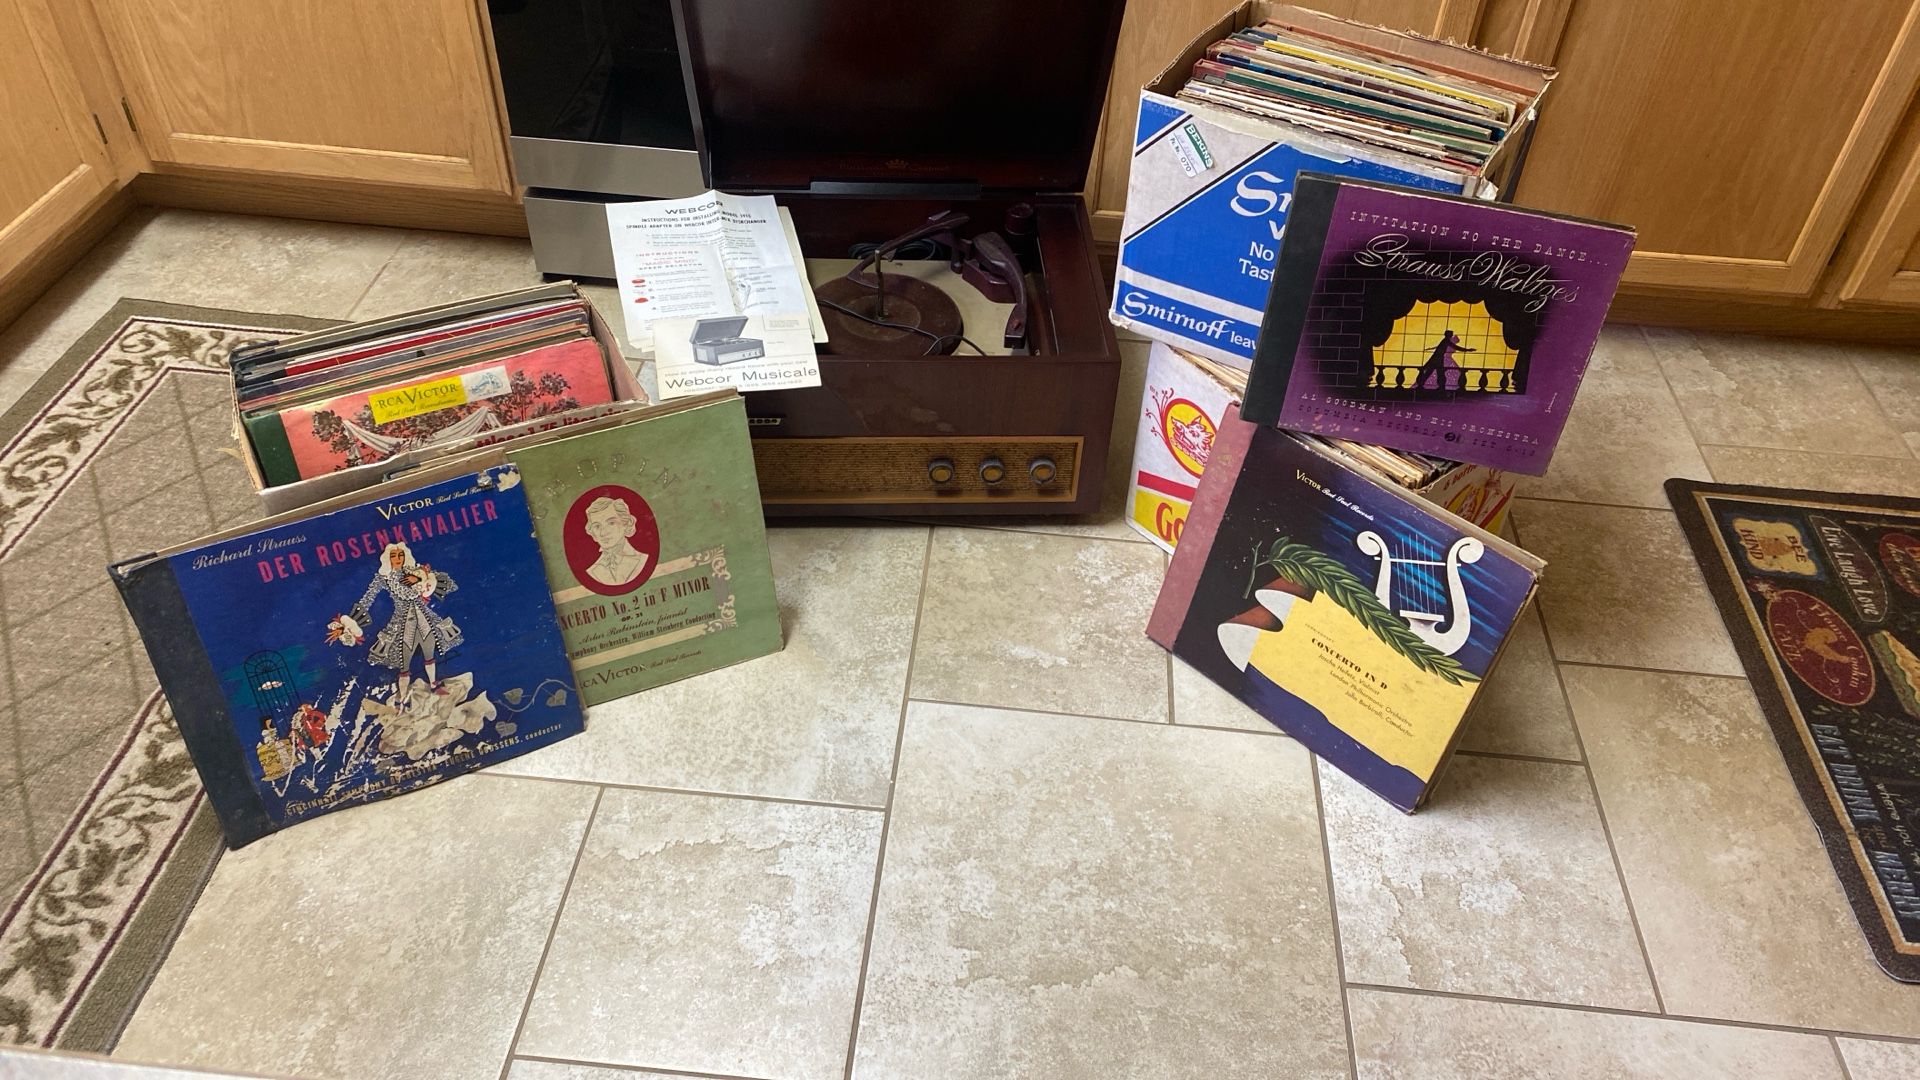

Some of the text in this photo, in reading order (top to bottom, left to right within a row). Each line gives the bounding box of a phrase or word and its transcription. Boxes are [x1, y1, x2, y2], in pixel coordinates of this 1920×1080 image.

[1181, 157, 1192, 172] 070
[1186, 124, 1213, 168] BEKINS
[665, 200, 723, 214] WEBCOR
[1350, 211, 1450, 236] INVITATION
[1461, 230, 1479, 242] TO
[1491, 235, 1522, 250] THE
[1249, 241, 1275, 261] No
[1239, 258, 1275, 282] Tast
[1354, 233, 1580, 313] Strauss Waltzes
[1122, 292, 1257, 350] Smirnoff leav
[377, 383, 458, 409] RCA VICTOR
[665, 375, 732, 389] Webcor
[742, 367, 817, 381] Musicale
[1298, 404, 1366, 424] COLUMBIA
[1472, 438, 1497, 449] SET
[1301, 393, 1539, 445] AL GOODMAN AND HIS ORCHESTRA
[376, 498, 434, 520] VICTOR
[435, 494, 452, 504] Red
[452, 489, 468, 500] Seal
[1296, 469, 1322, 491] VICTOR
[1350, 504, 1374, 521] Records
[192, 534, 307, 571] Richard Strauss
[257, 500, 498, 583] DER ROSENKAVALIER
[1740, 528, 1764, 560] KIND
[1785, 534, 1808, 563] BEE
[1820, 526, 1879, 615] Live Laugh Love
[560, 576, 710, 631] NCERTO No. 2 in F MINOR
[656, 607, 688, 625] pianist
[632, 629, 655, 640] William
[685, 612, 716, 625] Conducting
[1809, 603, 1848, 642] Home
[597, 663, 647, 684] VICTOR
[1311, 637, 1388, 690] CONCERTO IN D
[1330, 670, 1413, 728] London Philharmonic Orchestra
[525, 723, 562, 740] conductor
